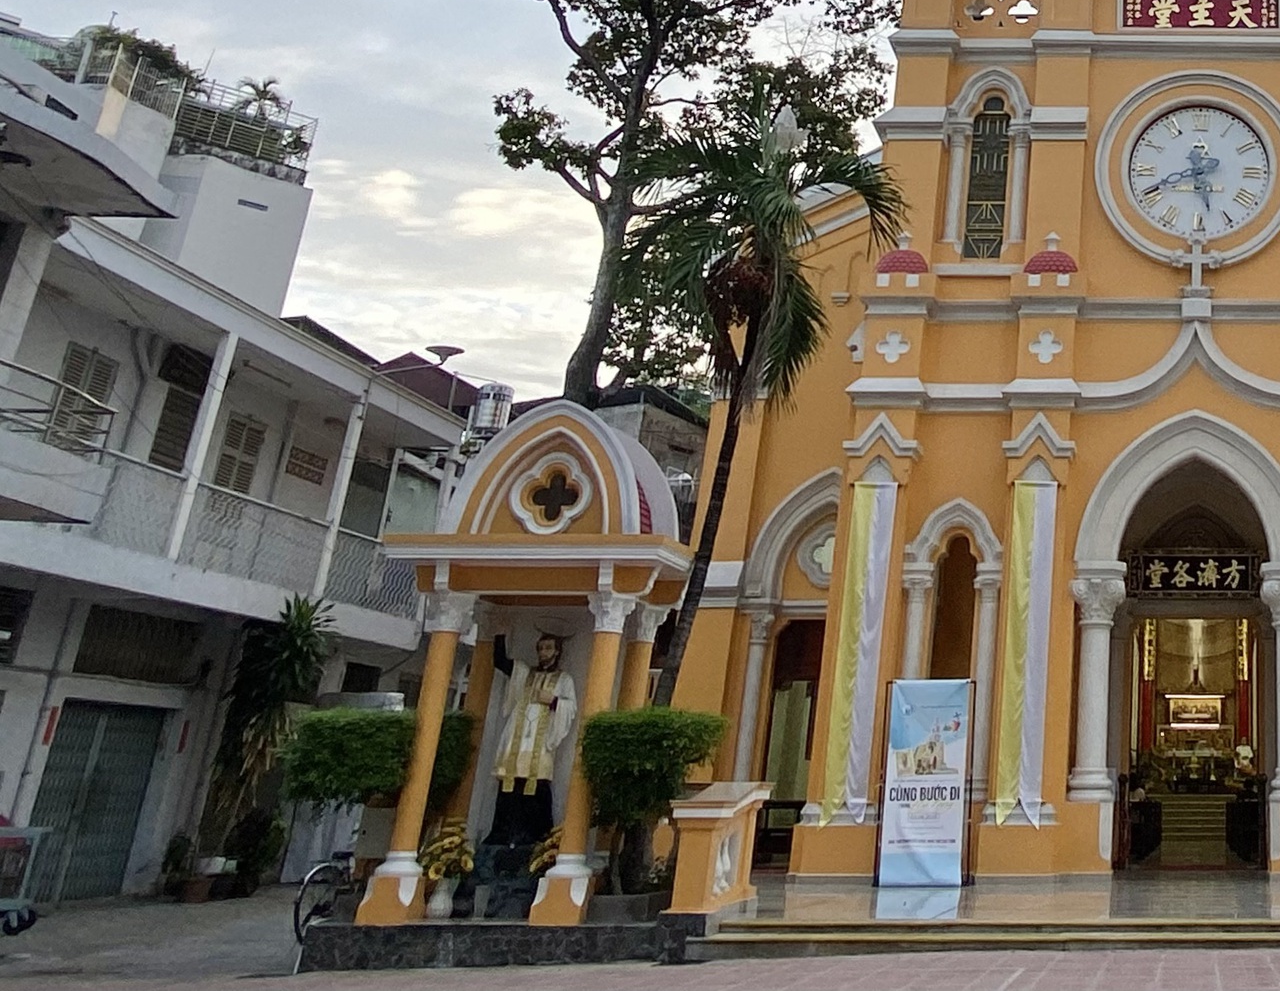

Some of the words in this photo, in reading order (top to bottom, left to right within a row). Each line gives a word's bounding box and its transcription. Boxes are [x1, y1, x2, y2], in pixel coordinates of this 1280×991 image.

[1235, 140, 1256, 156] II
[1242, 165, 1262, 179] III
[889, 784, 918, 801] CÙNG
